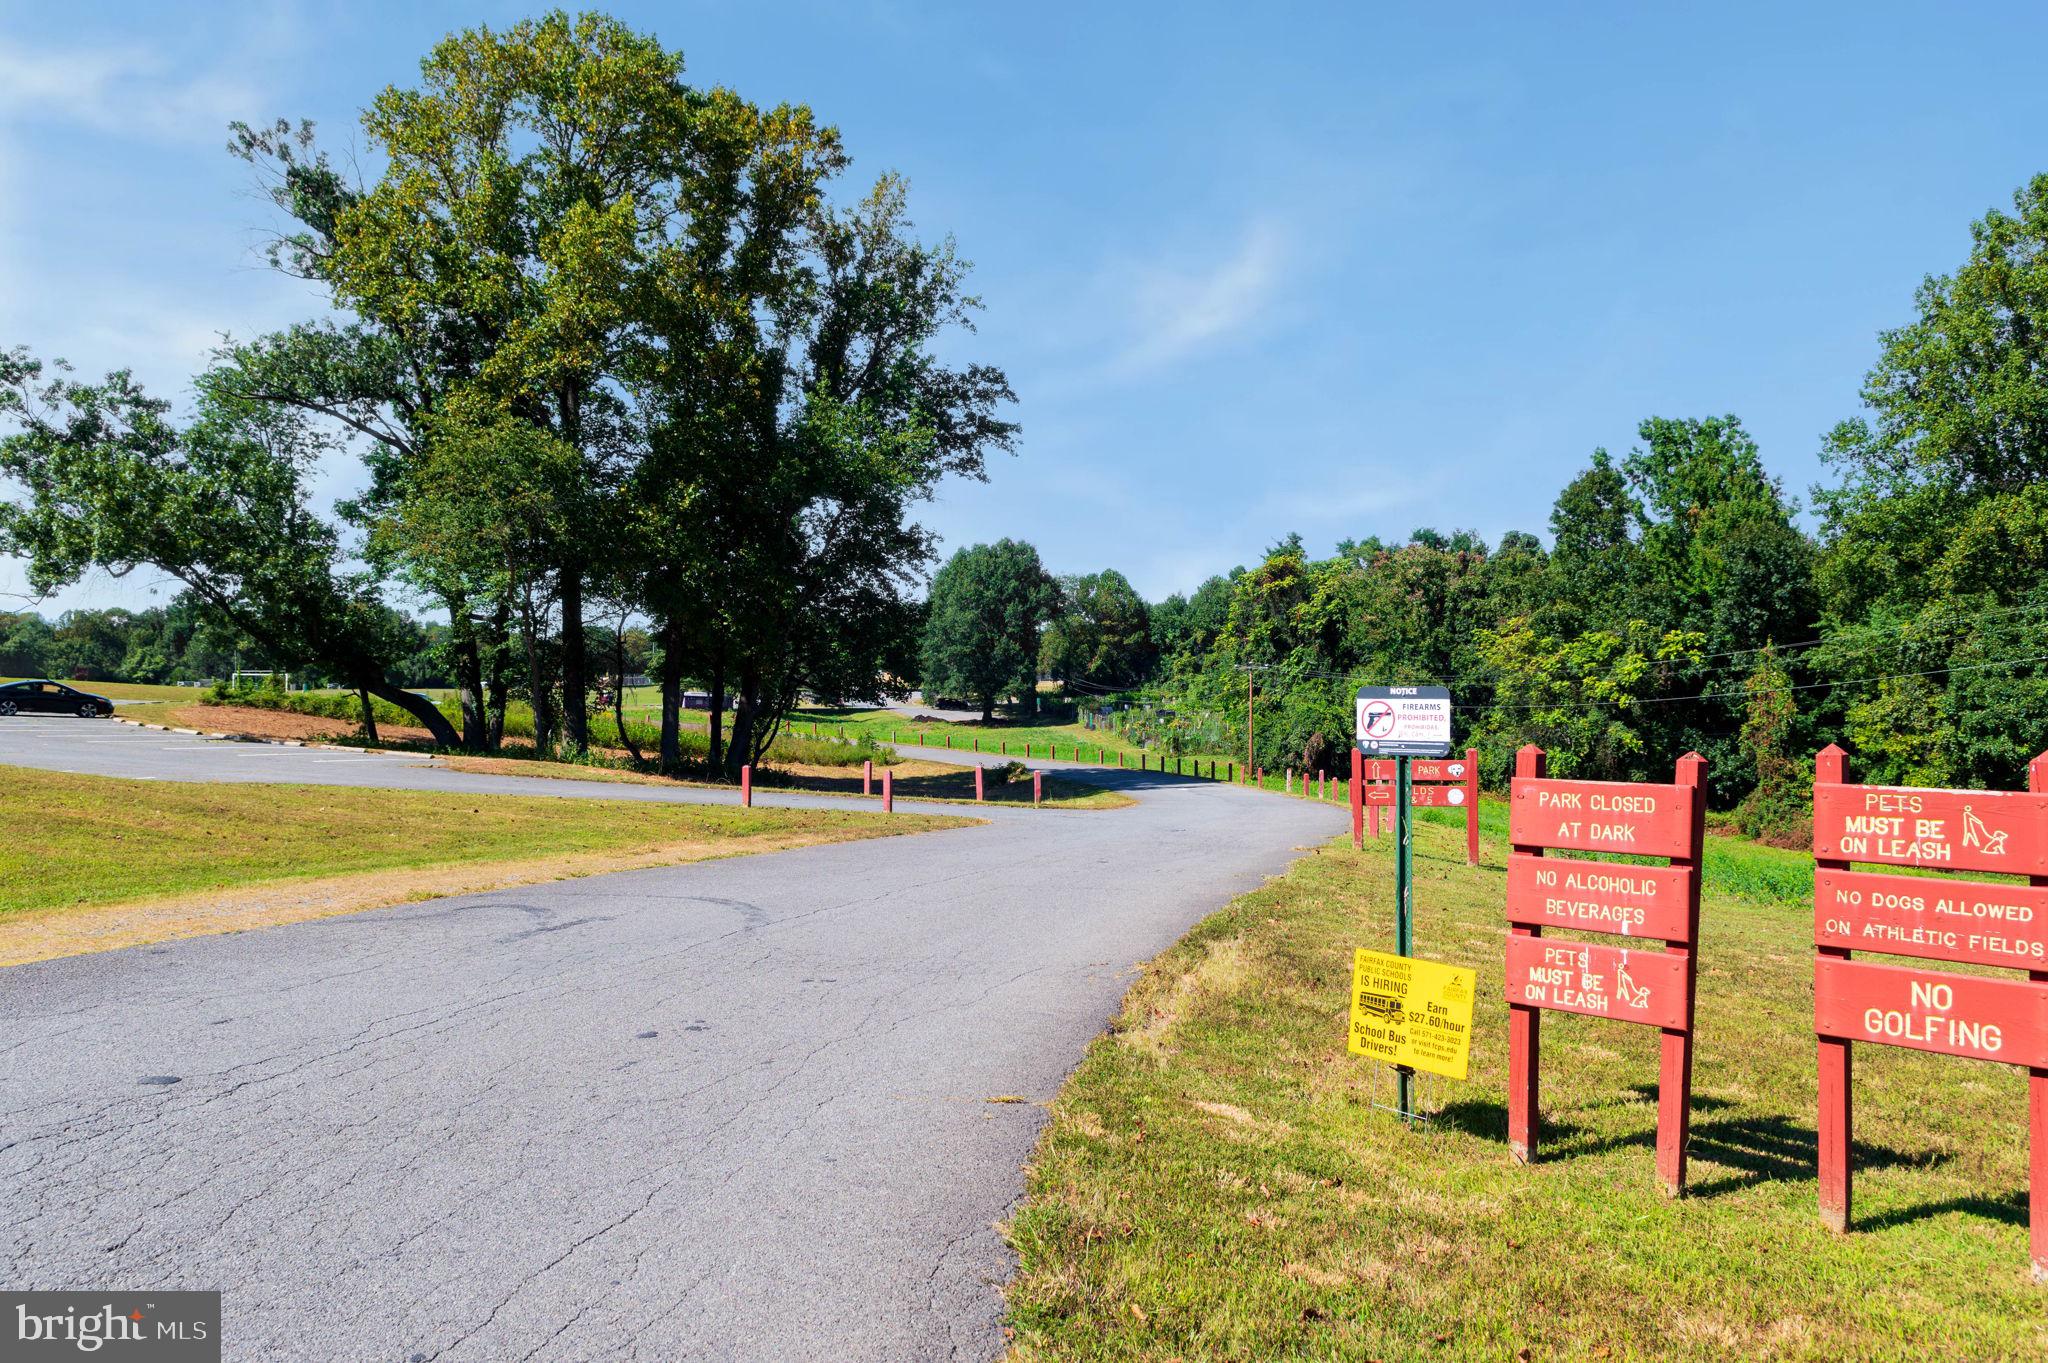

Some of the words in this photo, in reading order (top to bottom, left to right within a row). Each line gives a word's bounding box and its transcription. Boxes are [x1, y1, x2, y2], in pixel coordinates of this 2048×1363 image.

[1390, 687, 1417, 695] NOTICE
[1402, 703, 1441, 711] FIREARMS
[1418, 766, 1441, 775] PARK
[1539, 791, 1582, 809] PARK
[1590, 794, 1656, 814] CLOSED
[1865, 793, 1922, 813] PETS
[1557, 822, 1582, 838] AT
[1591, 823, 1636, 842] DARK
[1845, 815, 1904, 837] MUST
[1915, 819, 1945, 839] BE
[1839, 836, 1867, 854] ON
[1877, 839, 1951, 861] LEASH
[1536, 870, 1557, 887] NO
[1565, 873, 1657, 897] ALCOHOLIC
[1546, 898, 1645, 925] BEVERAGES
[1836, 889, 1862, 906] NO
[1871, 892, 1925, 912] DOGS
[1935, 898, 2034, 923] ALLOWED
[1825, 918, 1851, 936] ON
[1863, 922, 1957, 948] ATHLETIC
[1969, 934, 2045, 958] FIELDS
[1359, 954, 1385, 967] FAIRFAX
[1386, 960, 1412, 971] COUNTY
[1545, 947, 1589, 968] PETS
[1359, 963, 1381, 975] PUBLIC
[1382, 968, 1412, 982] SCHOOLS
[1529, 966, 1574, 987] MUST
[1581, 973, 1604, 992] BE
[1360, 974, 1370, 987] IS
[1373, 976, 1408, 995] HIRING
[1525, 983, 1546, 1001] ON
[1553, 987, 1608, 1012] LEASH
[1910, 980, 1953, 1011] NO
[1427, 1001, 1448, 1016] Earn
[1408, 1011, 1465, 1033] $27.60/hour
[1409, 1027, 1421, 1036] Call
[1864, 1007, 2003, 1053] GOLFING
[1353, 1021, 1386, 1040] School
[1388, 1030, 1407, 1045] Bus
[1360, 1036, 1398, 1056] Drivers!
[1413, 1047, 1420, 1055] to
[1420, 1049, 1436, 1059] learn
[1436, 1053, 1454, 1063] more!
[1418, 1039, 1431, 1048] visit
[1432, 1042, 1458, 1055] fcps.edu
